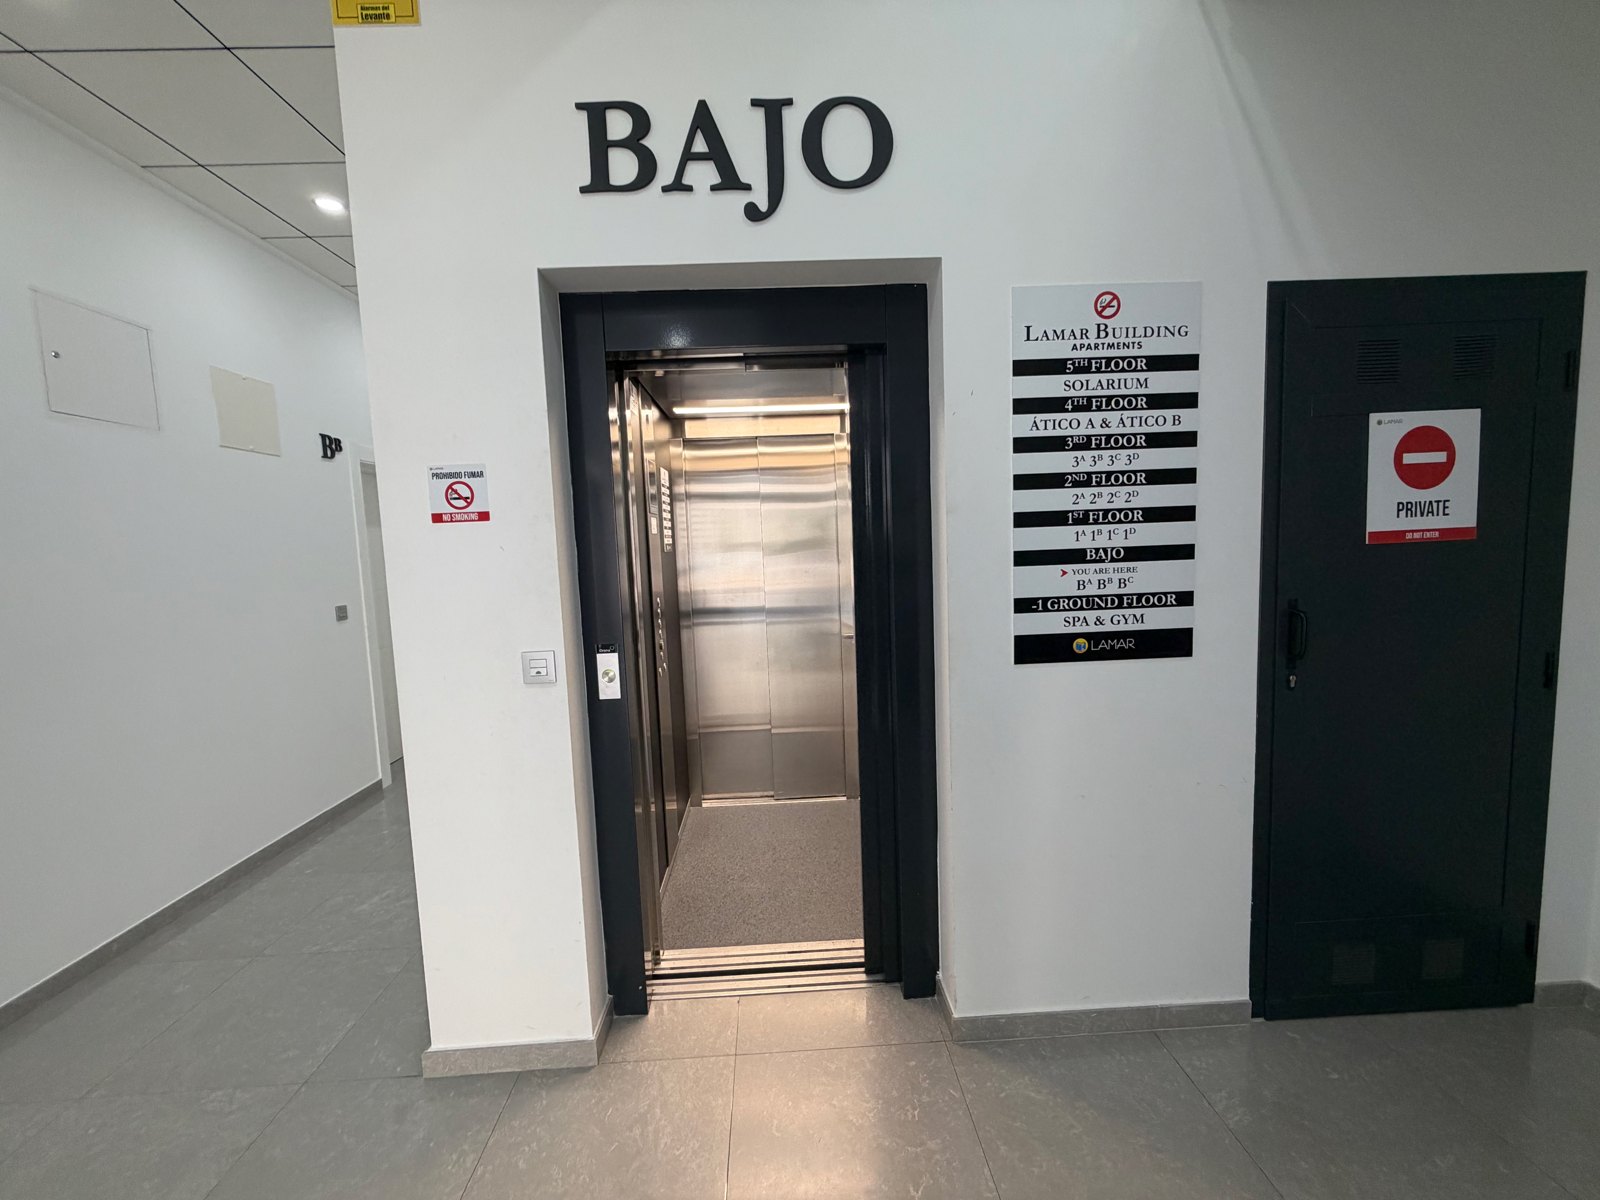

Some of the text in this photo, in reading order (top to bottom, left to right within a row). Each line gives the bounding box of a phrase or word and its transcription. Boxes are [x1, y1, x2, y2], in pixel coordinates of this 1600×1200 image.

[360, 12, 390, 20] Levante
[574, 96, 894, 222] BAJO
[1071, 341, 1143, 351] APARTMENTS
[1066, 358, 1148, 372] 5TH FLOOR
[1063, 378, 1149, 391] SOLARIUM
[1064, 396, 1148, 411] 4TH FLOOR
[1029, 414, 1182, 431] ÁTICO A & ÁTICO B
[1065, 435, 1147, 449] 3RD FLOOR
[432, 470, 484, 480] PROHIBIDO FUMAR
[1064, 473, 1147, 487] 2ND FLOOR
[1396, 499, 1450, 518] PRIVATE
[452, 513, 478, 521] SMOKING
[1067, 510, 1144, 524] 1ST FLOOR
[1086, 547, 1124, 562] BAJO
[1032, 594, 1177, 611] -1 GROUND FLOOR
[1063, 614, 1145, 628] SPA & GYM
[1091, 639, 1135, 650] LAMAR
